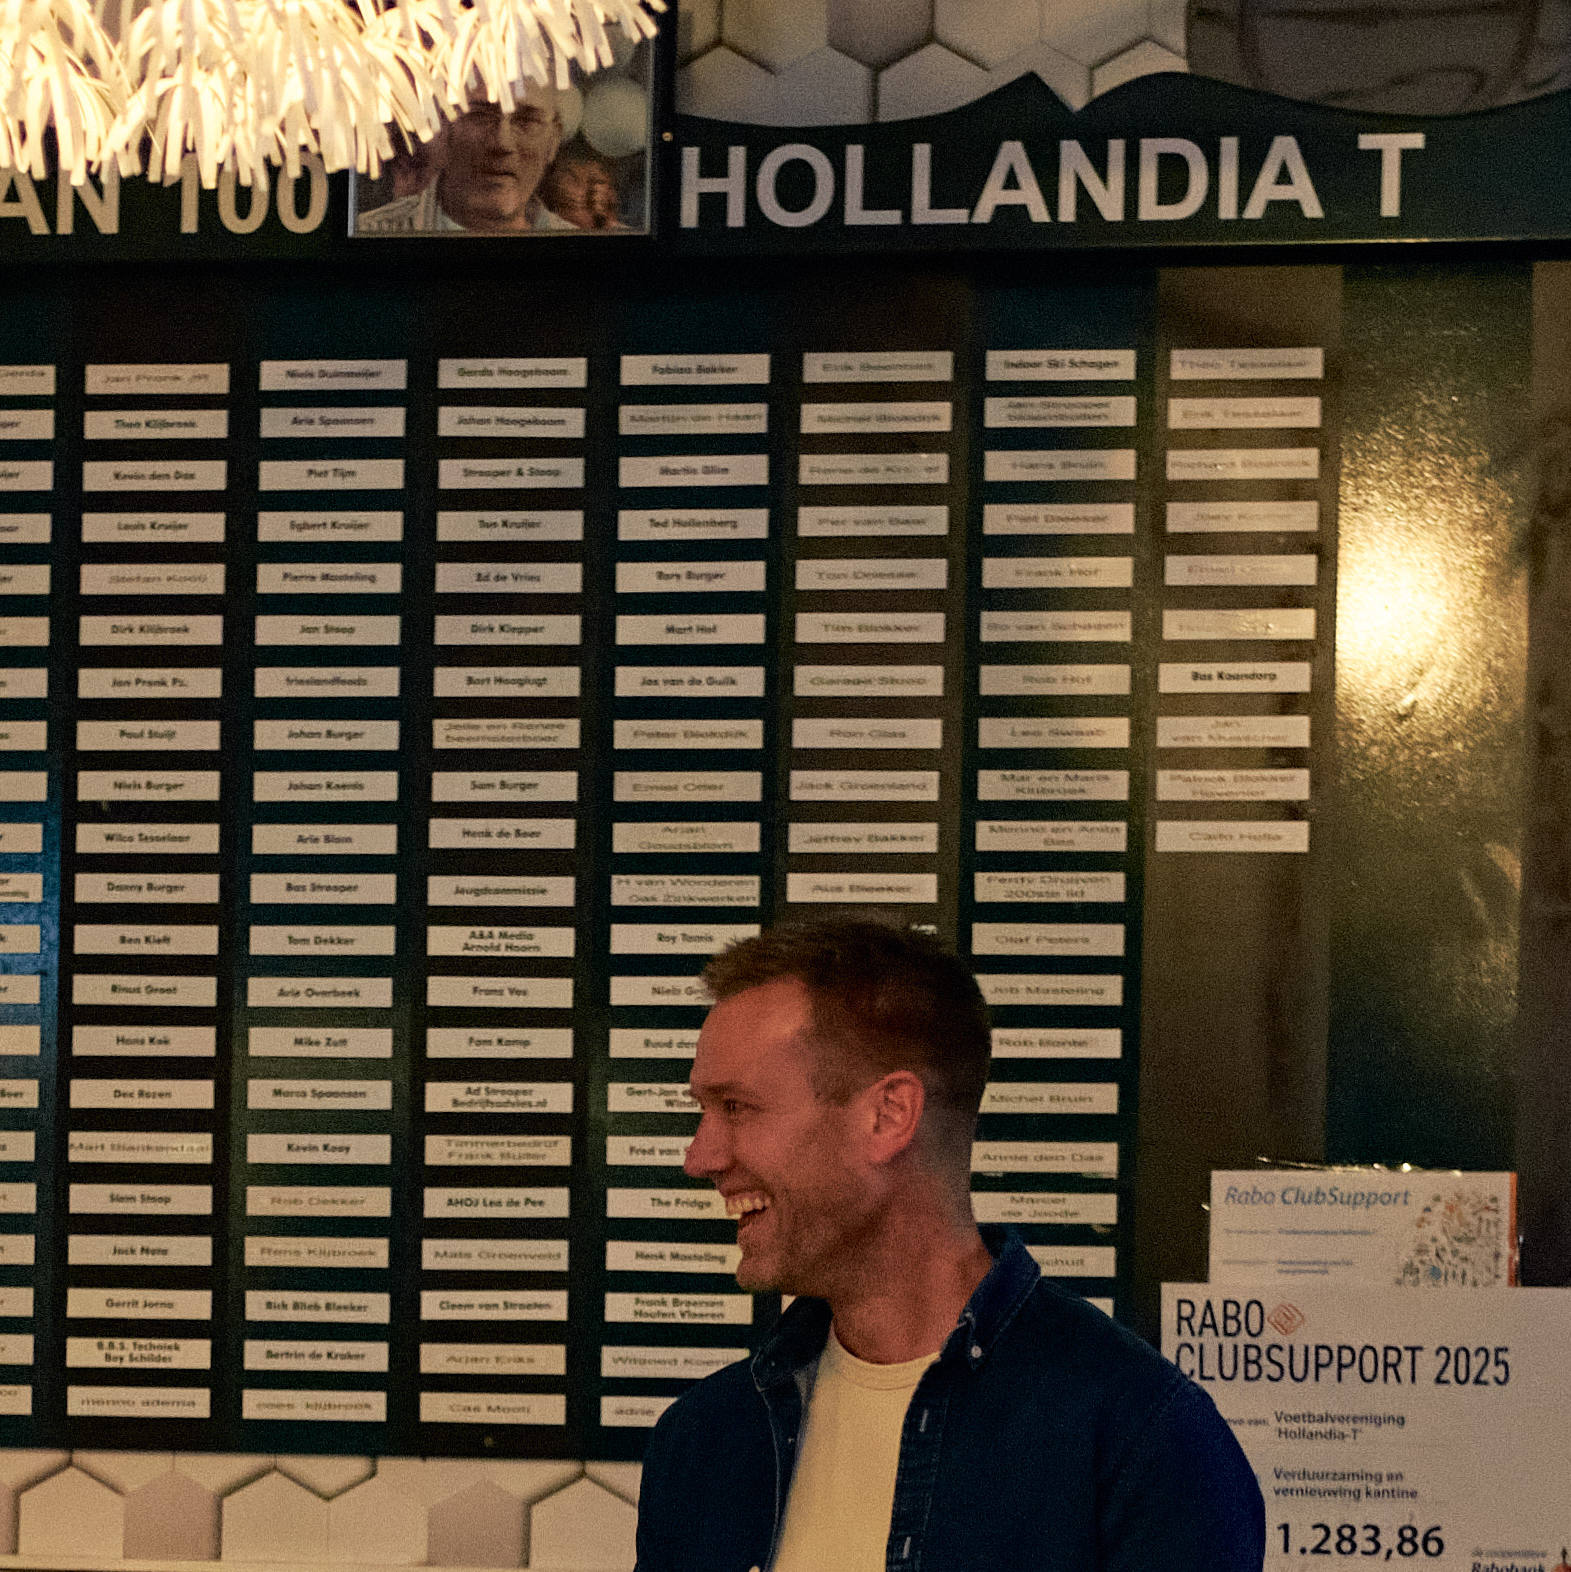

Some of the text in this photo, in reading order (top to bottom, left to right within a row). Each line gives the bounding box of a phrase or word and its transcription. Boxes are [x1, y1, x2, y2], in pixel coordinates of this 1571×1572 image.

[163, 152, 330, 235] 100
[680, 135, 1325, 228] HOLLANDIA
[1357, 132, 1426, 218] T
[687, 677, 702, 686] de
[325, 729, 364, 741] Burger
[145, 781, 184, 792] Burger
[499, 780, 539, 792] Burger
[296, 835, 320, 844] Arie
[454, 886, 548, 897] Jeugdcommissie
[119, 935, 141, 944] Ben
[287, 935, 355, 945] Tom Dekker
[498, 932, 533, 940] Media
[463, 942, 501, 952] Arnold
[294, 1037, 321, 1046] Mike
[1224, 1185, 1411, 1210] Rabo ClubSupport
[650, 1198, 712, 1209] The Fridge
[635, 1251, 665, 1260] Henk
[105, 1298, 139, 1308] Gerrit
[1175, 1299, 1265, 1338] RABO
[129, 1353, 171, 1362] Schilder
[308, 1351, 323, 1360] de
[1175, 1343, 1511, 1387] CLUBSUPPORT 2025
[1273, 1411, 1406, 1429] Voetbalvereniging
[1273, 1467, 1404, 1485] Verduurzaming en
[1273, 1486, 1418, 1502] vernieuwing kantine
[1278, 1523, 1445, 1562] 1.283,86
